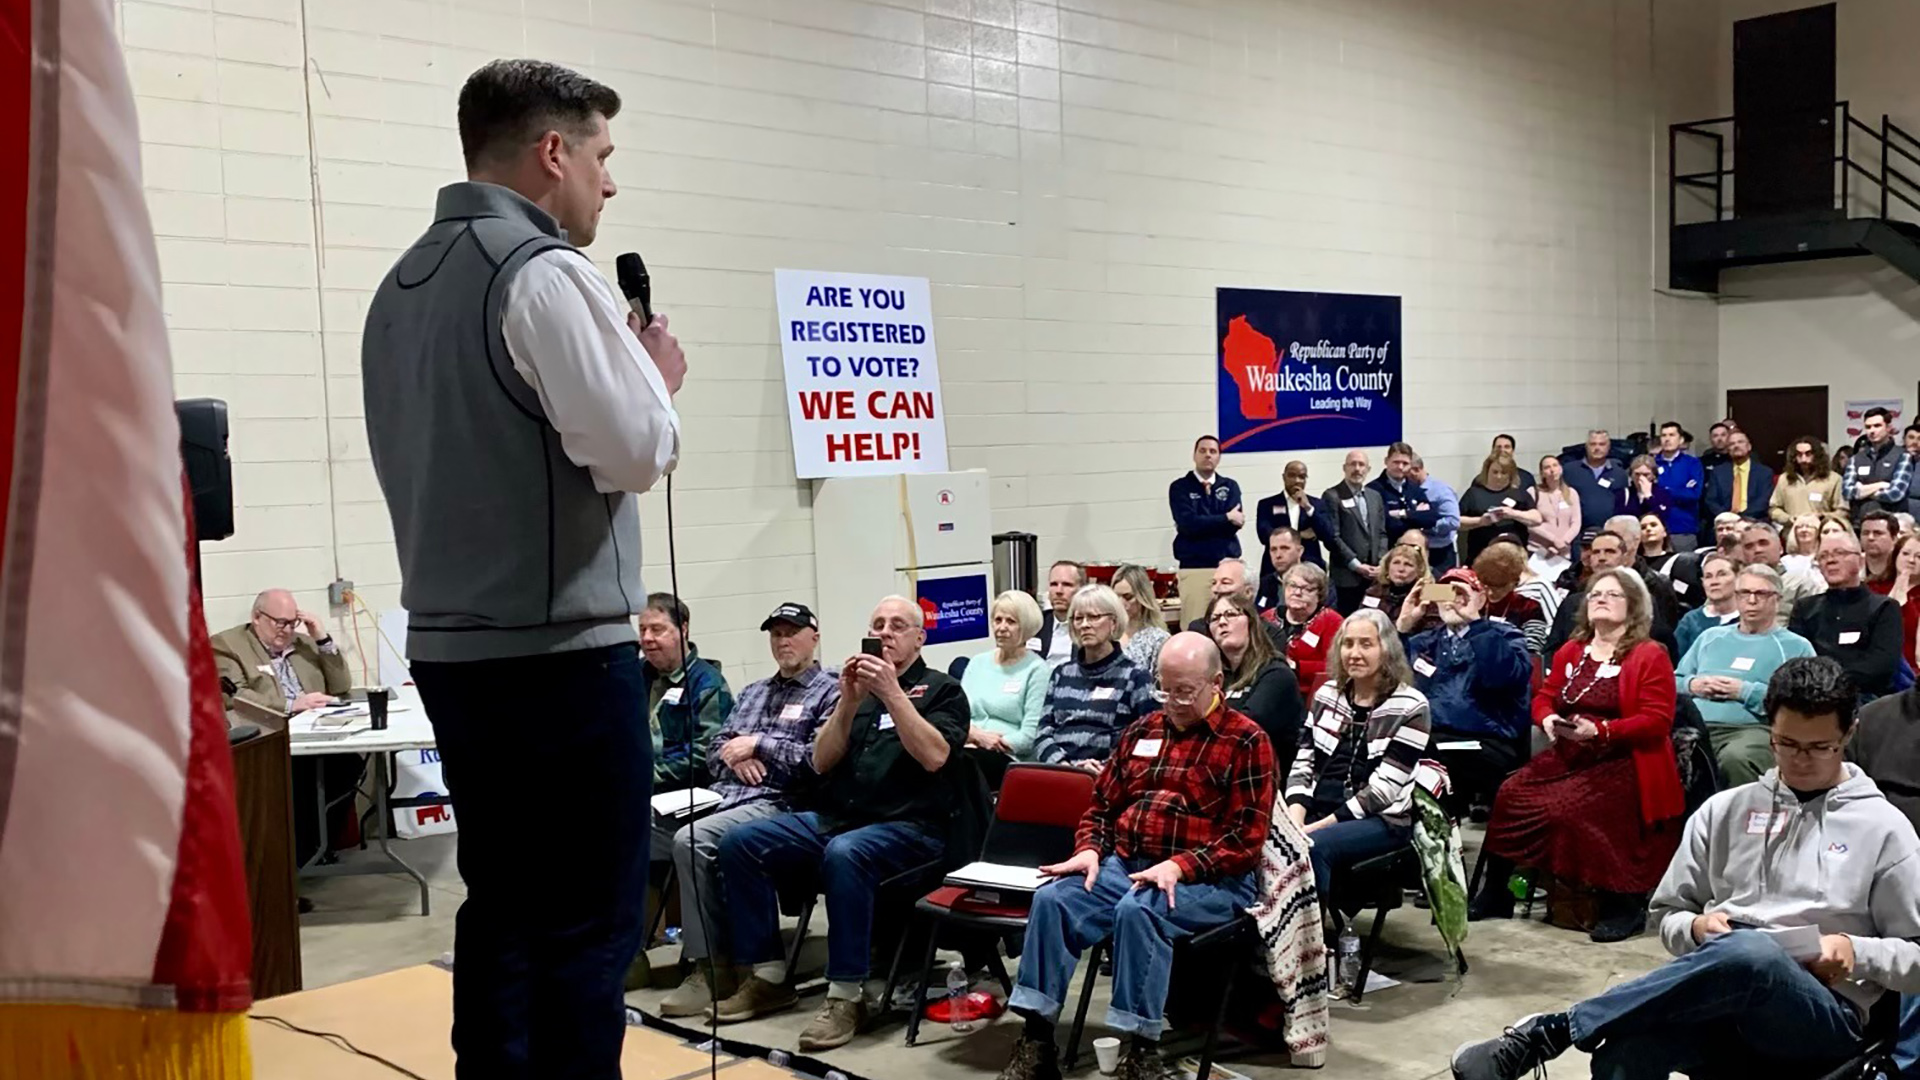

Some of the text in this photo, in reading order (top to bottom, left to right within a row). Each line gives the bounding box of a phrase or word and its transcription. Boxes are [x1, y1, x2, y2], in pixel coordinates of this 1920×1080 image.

[806, 286, 905, 310] ARE YOU
[791, 320, 926, 344] REGISTERED
[1289, 339, 1390, 365] Republican Party of
[806, 356, 919, 378] TO VOTE?
[1245, 364, 1393, 398] Waukesha County
[798, 390, 935, 420] WE CAN
[1310, 396, 1373, 412] Leading the Way
[826, 432, 921, 463] HELP!
[925, 607, 984, 620] Waukesha County
